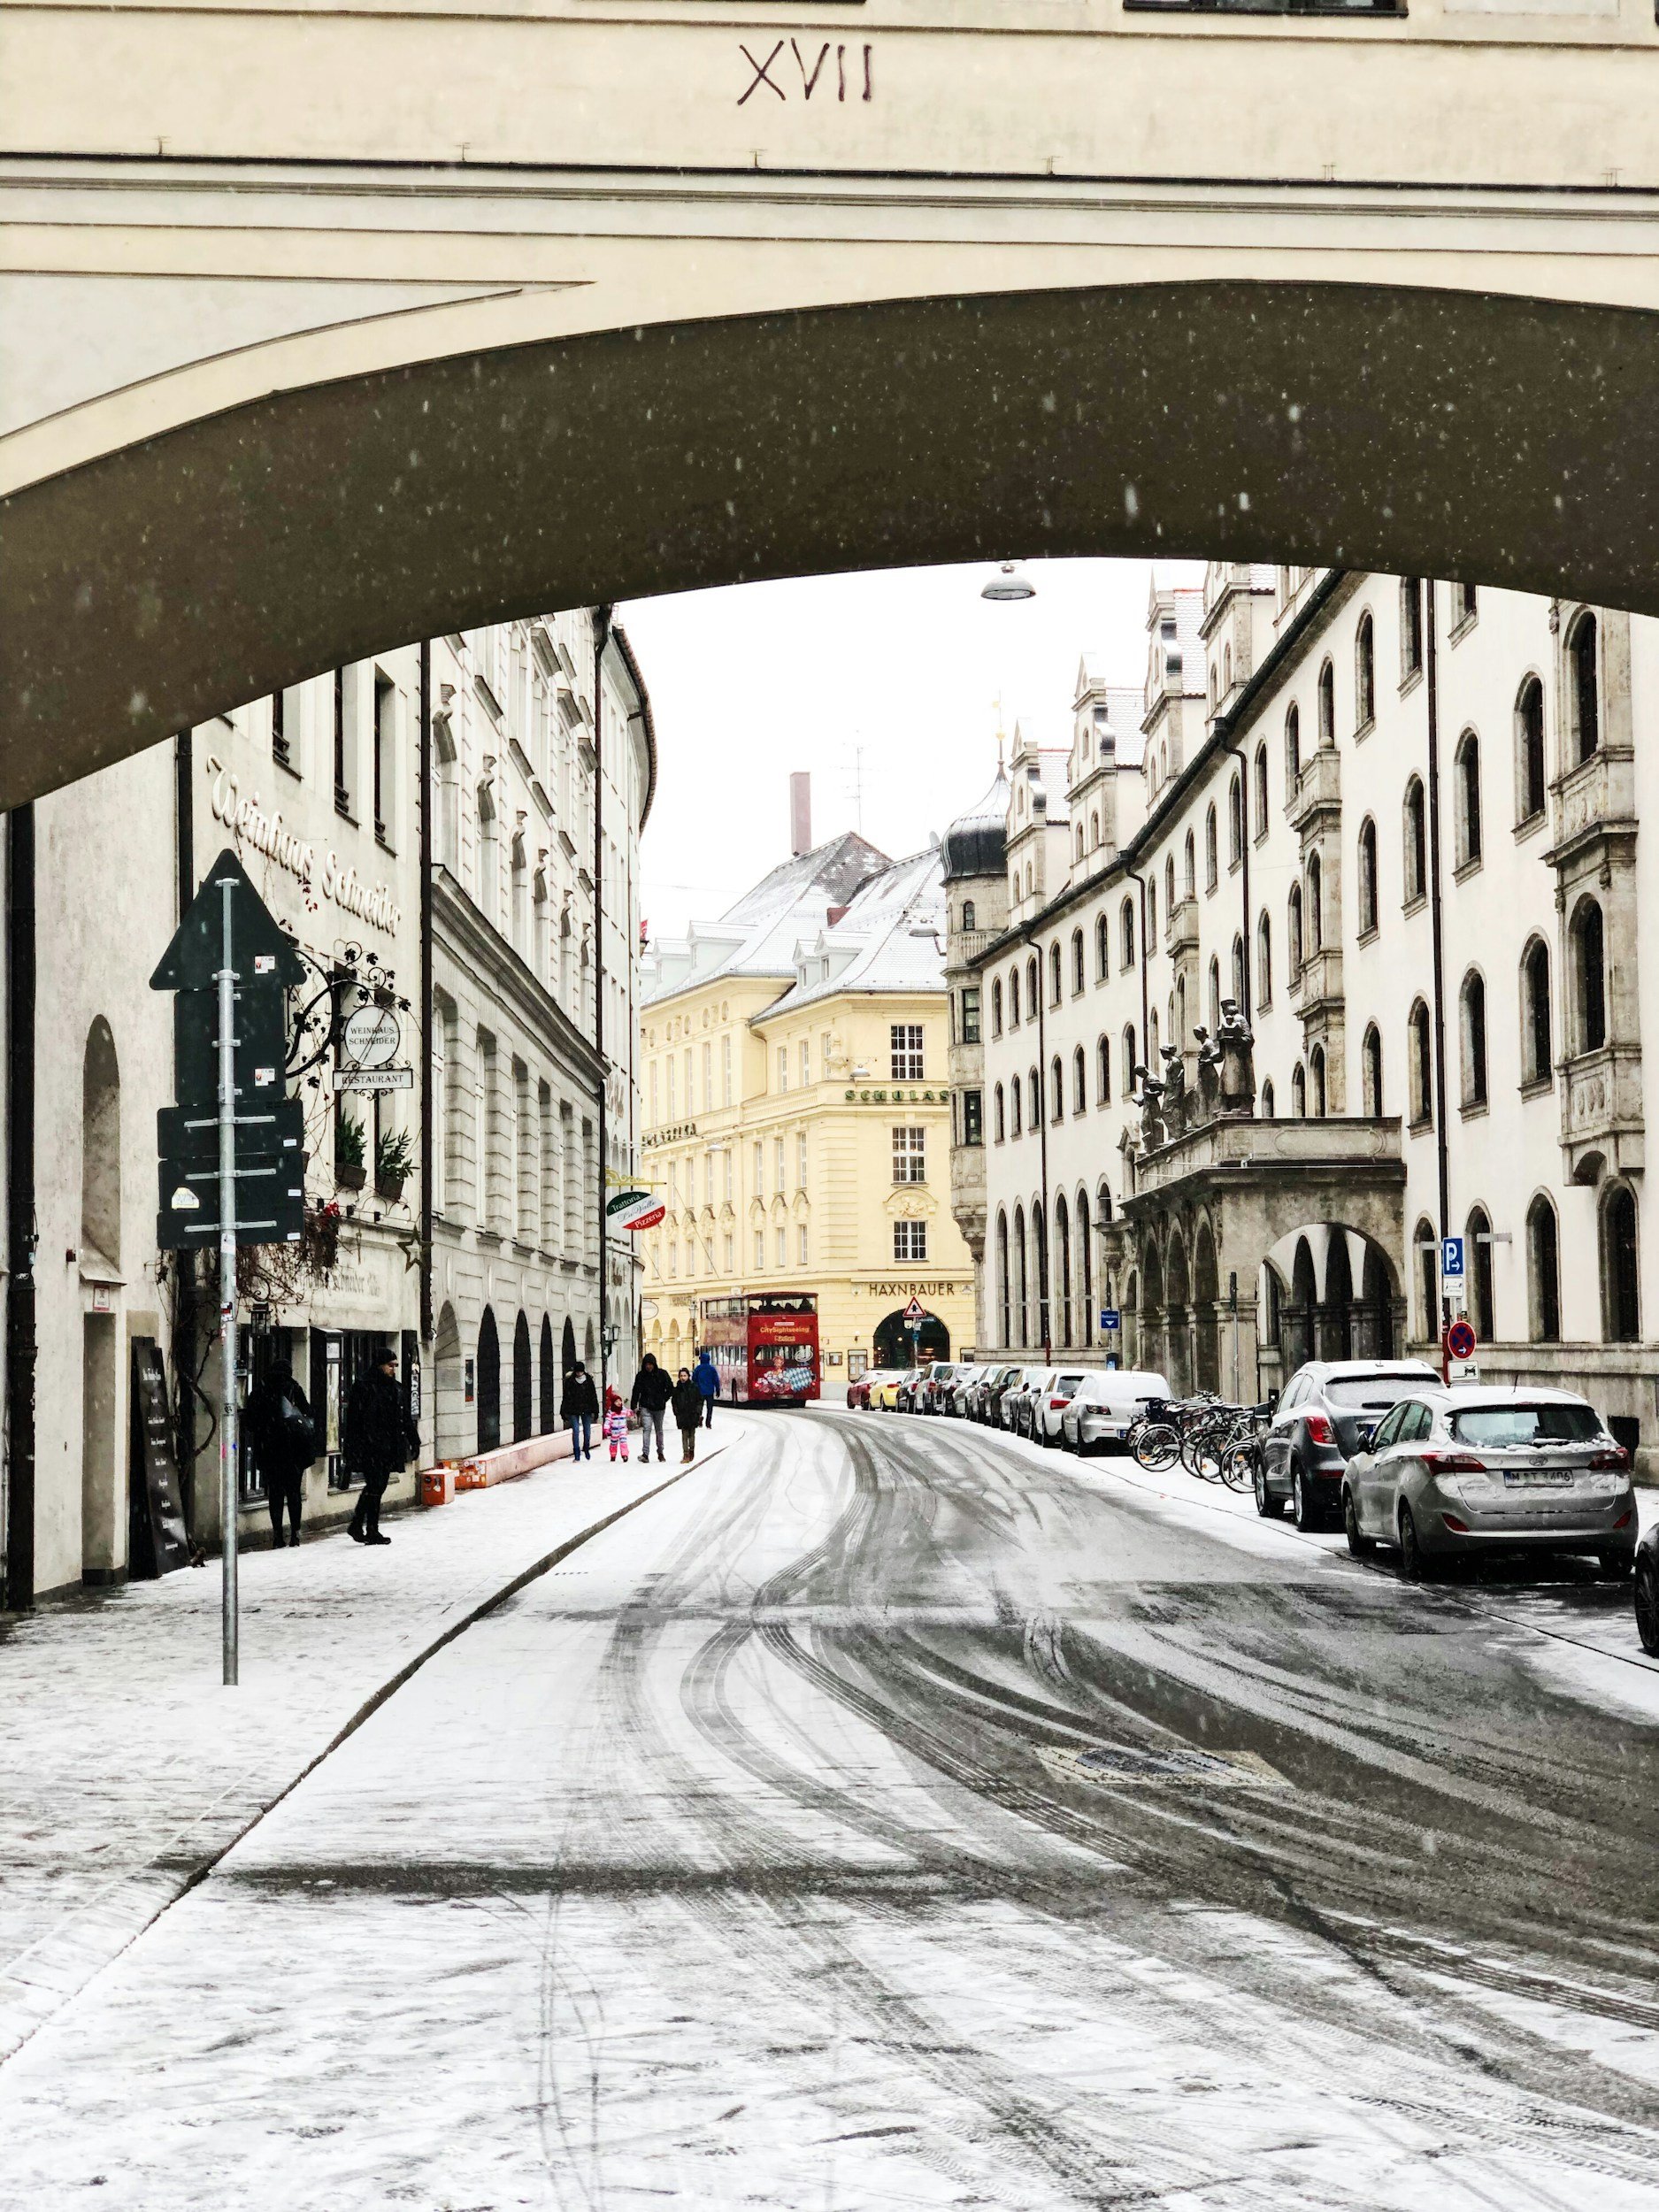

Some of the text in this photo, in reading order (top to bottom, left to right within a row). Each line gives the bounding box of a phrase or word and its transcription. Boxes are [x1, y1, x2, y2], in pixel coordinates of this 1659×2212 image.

[737, 37, 872, 106] XVII
[206, 754, 401, 938] Weinhaus Schneider
[342, 1074, 403, 1085] RESTAURANT
[611, 1194, 641, 1211] Trattoria
[634, 1211, 663, 1228] Pizzeria
[1446, 1242, 1458, 1271] P
[869, 1283, 955, 1296] HAXNBAUER
